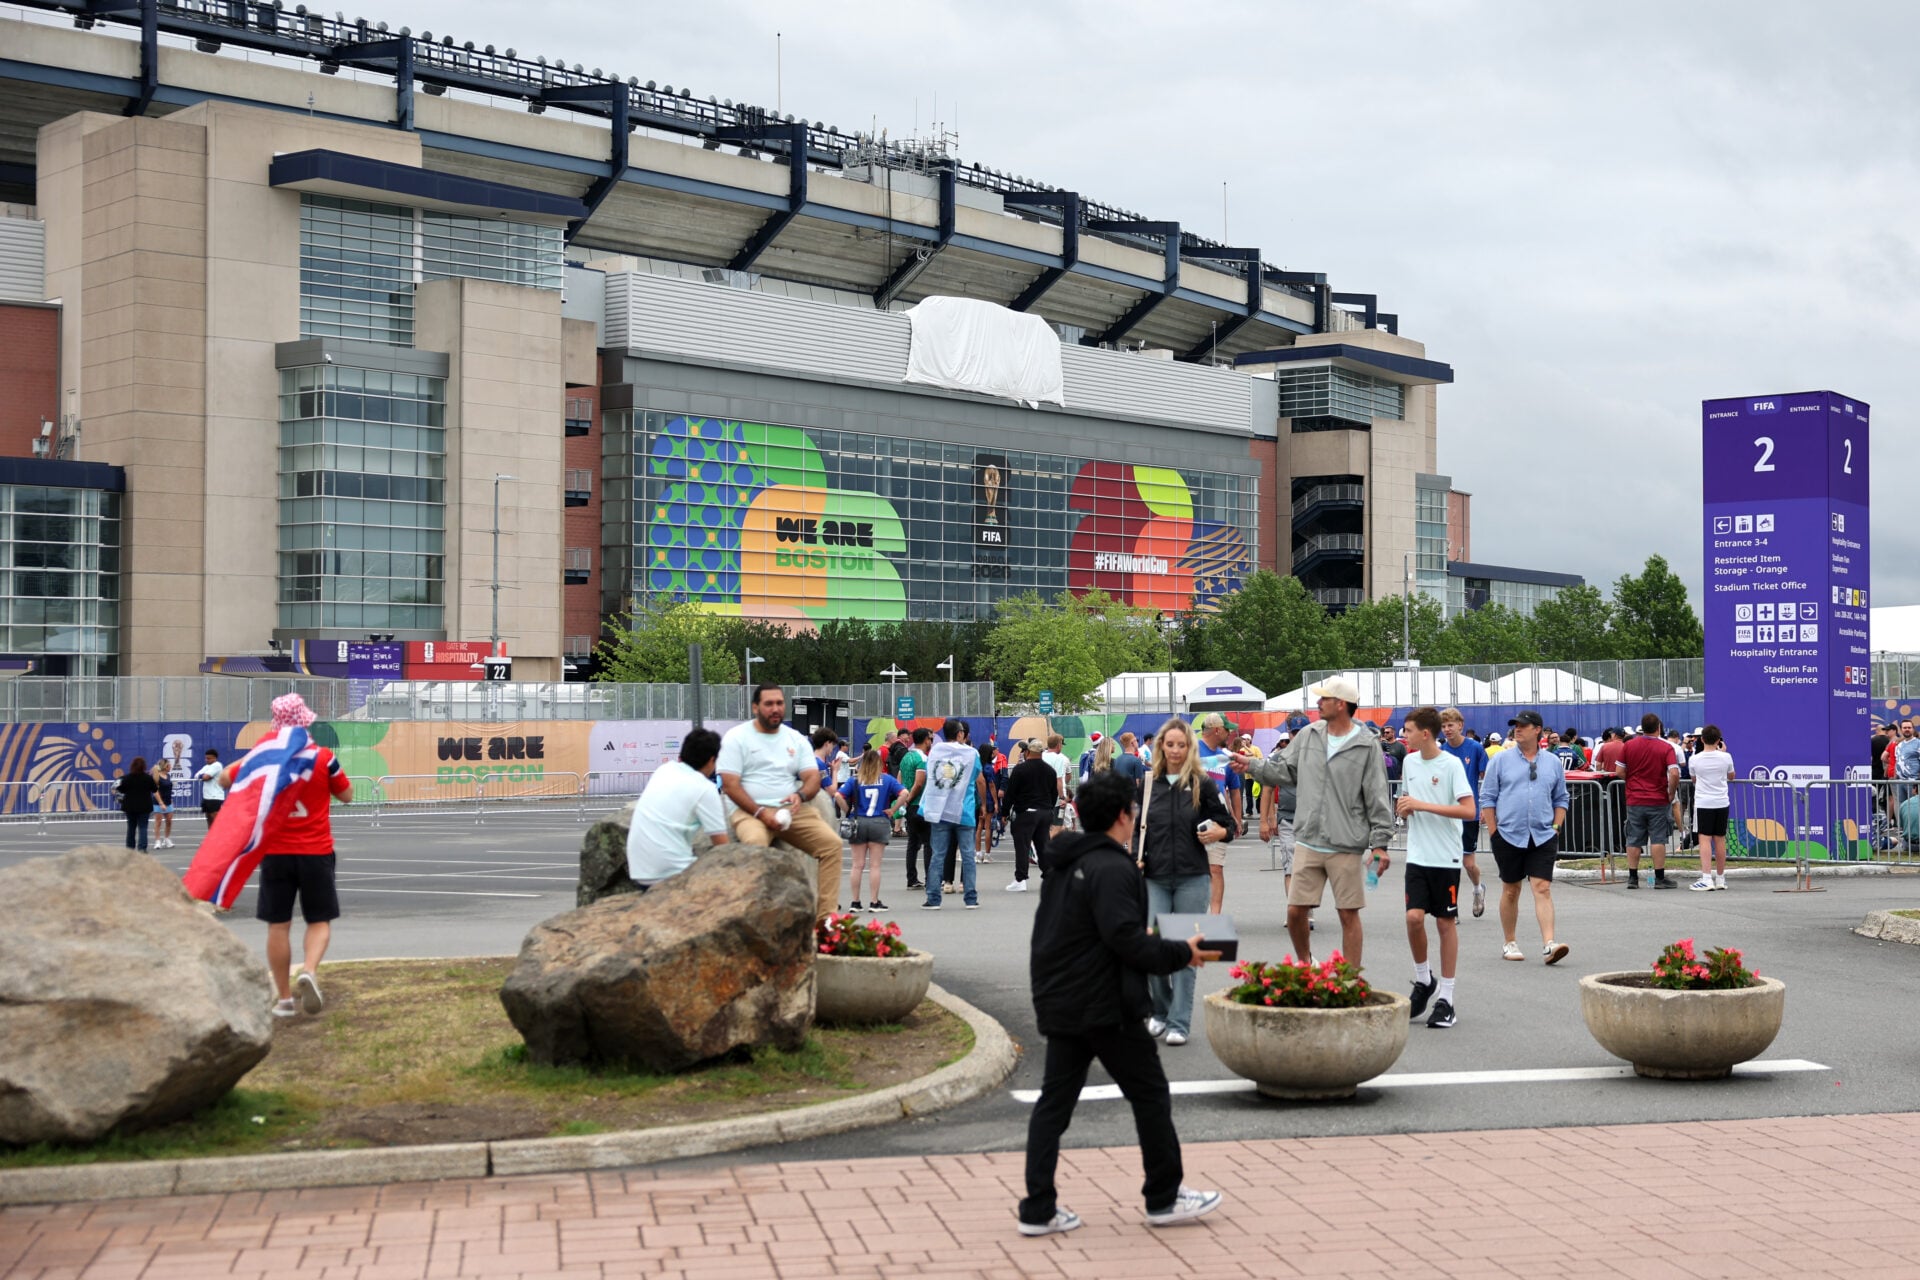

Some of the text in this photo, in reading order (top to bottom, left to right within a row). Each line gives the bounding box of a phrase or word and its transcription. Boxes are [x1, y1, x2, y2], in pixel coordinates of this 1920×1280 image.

[1754, 402, 1775, 411] FIFA
[1790, 405, 1820, 413] ENTRANCE
[1709, 411, 1739, 419] ENTRANCE
[1754, 436, 1775, 472] 2
[1844, 438, 1852, 474] 2
[776, 517, 873, 548] WE ARE
[982, 530, 1001, 543] FIFA
[1714, 538, 1768, 548] Entrance 3-4
[776, 547, 874, 571] BOSTON
[1095, 552, 1168, 576] #FIFAWorldCup
[1714, 555, 1781, 564] Restricted Item
[971, 563, 1011, 579] 2026
[1714, 567, 1748, 577] Storage
[1755, 565, 1788, 575] Orange
[1714, 581, 1807, 592] Stadium Ticket Office
[435, 652, 478, 663] HOSPITALITY
[1730, 648, 1818, 658] Hospitality Entrance
[494, 665, 506, 680] 22
[1763, 665, 1818, 673] Stadium Fan
[1770, 676, 1818, 686] Experience
[438, 736, 544, 761] WE ARE
[437, 764, 544, 784] BOSTON
[171, 789, 192, 797] 026
[865, 788, 879, 817] 7
[1449, 885, 1457, 905] 1
